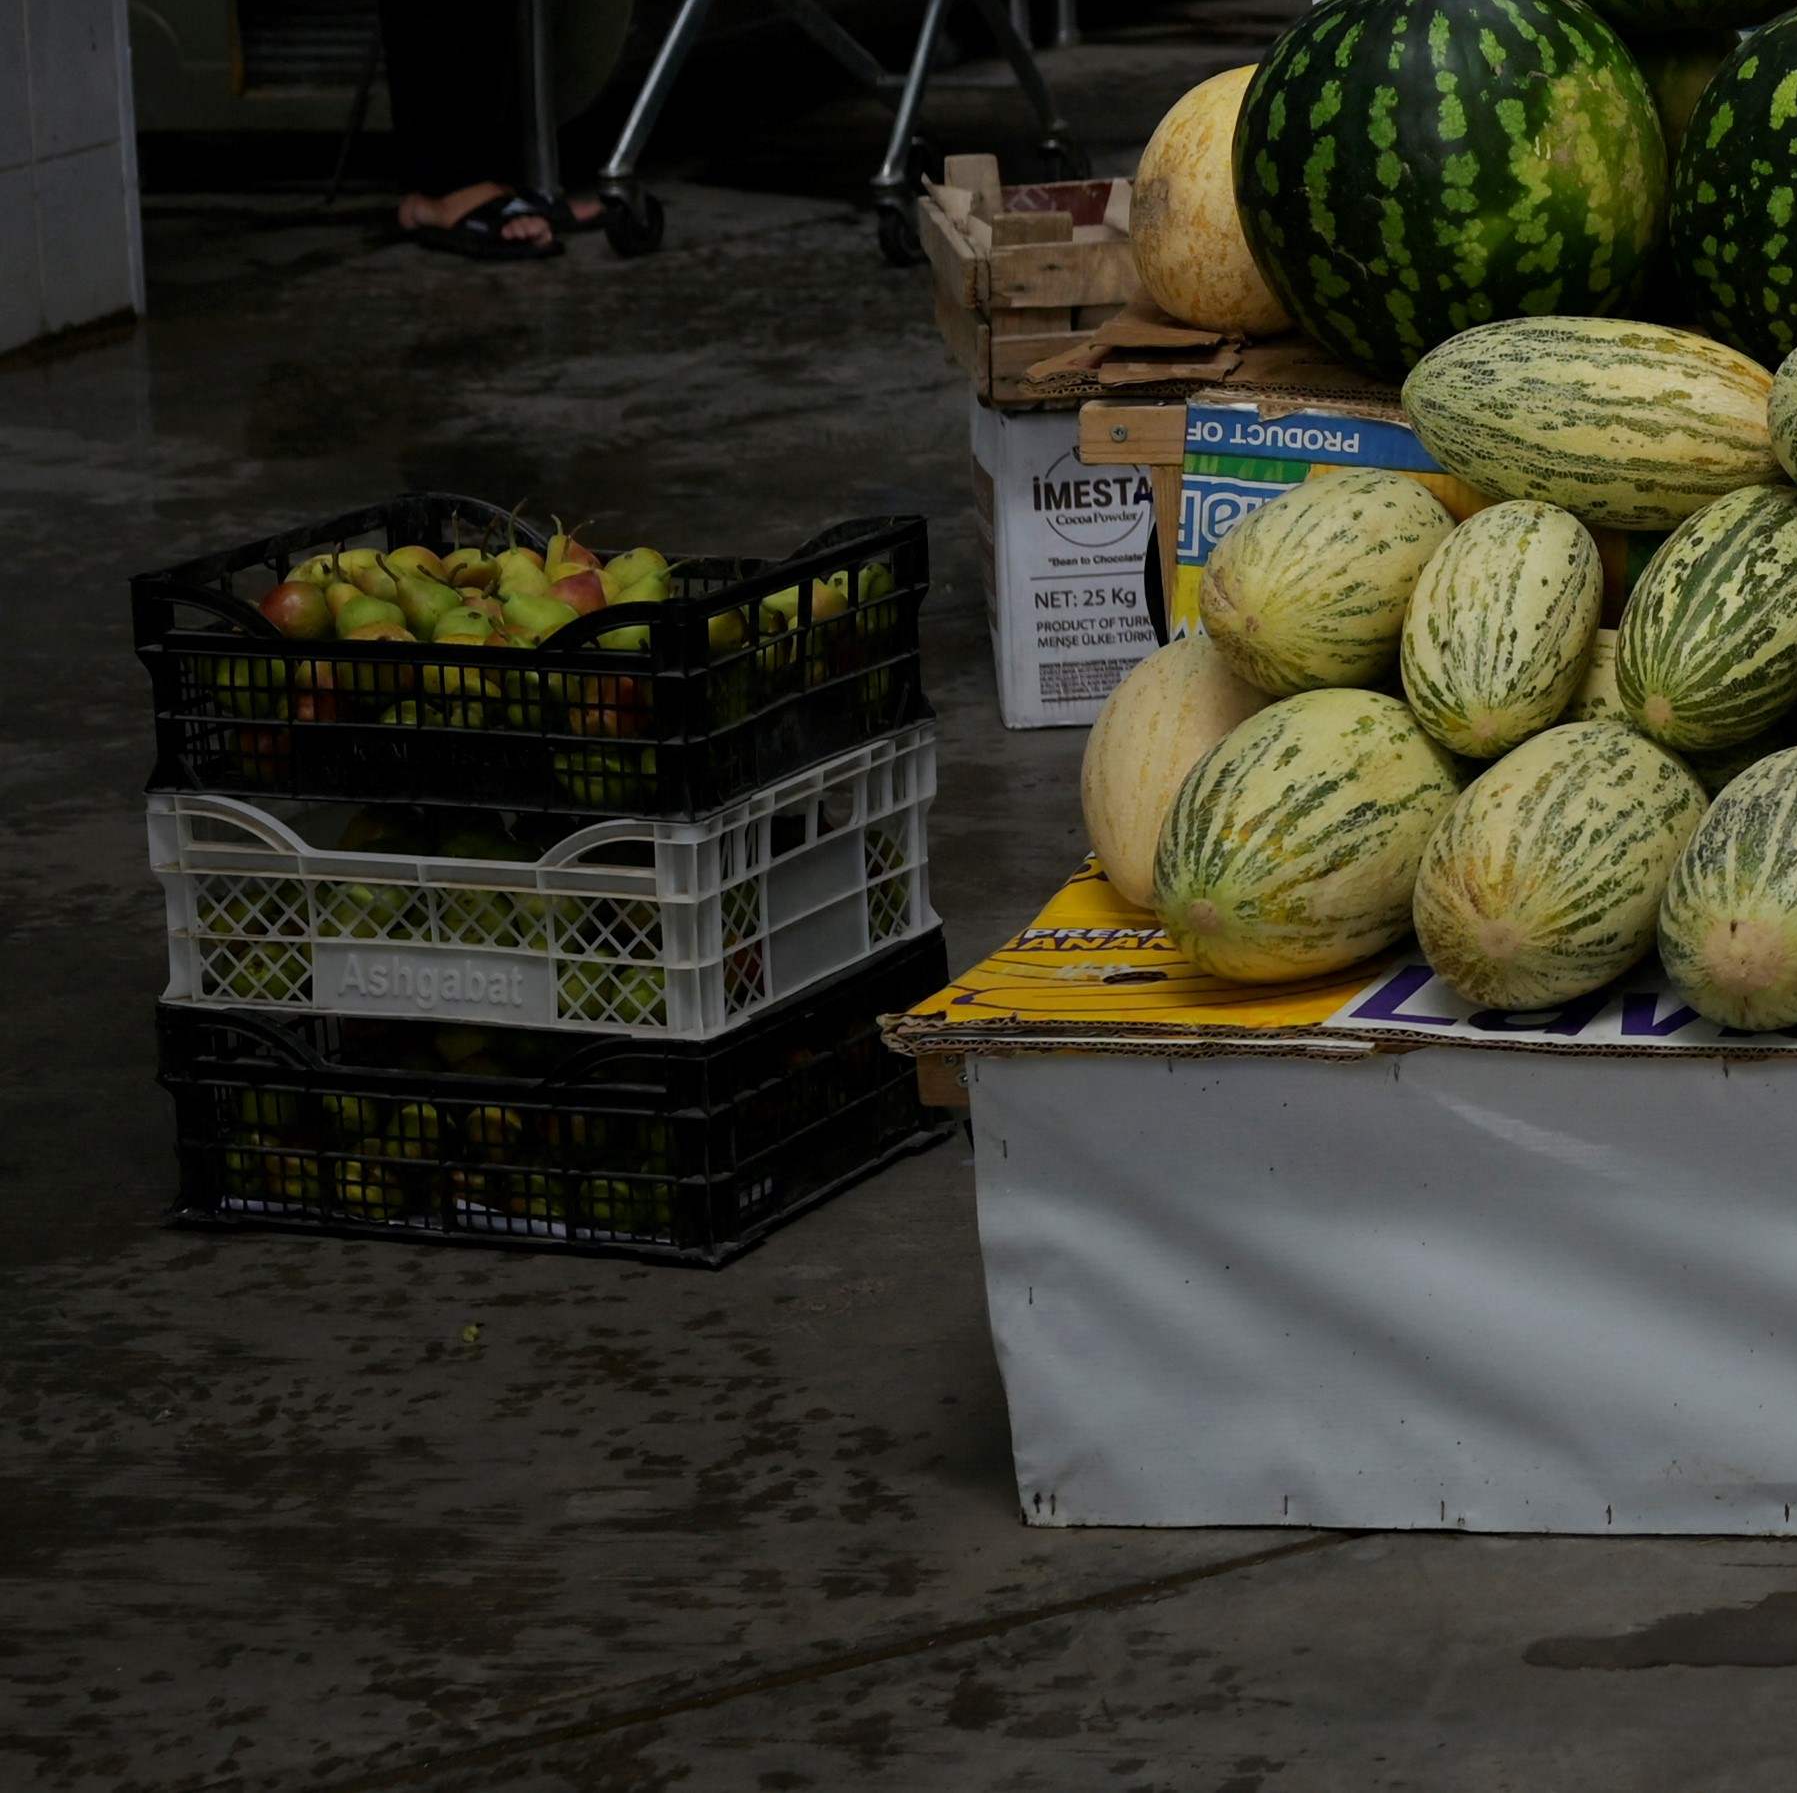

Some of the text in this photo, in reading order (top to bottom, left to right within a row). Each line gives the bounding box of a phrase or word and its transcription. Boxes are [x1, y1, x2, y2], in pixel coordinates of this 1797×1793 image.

[1187, 421, 1360, 454] PRODUCT OF
[1033, 475, 1153, 511] İMESTA
[1055, 510, 1138, 526] Cocoa Powder
[1080, 556, 1091, 566] to
[1034, 587, 1137, 609] NET: 25 Kg
[1036, 618, 1096, 633] PRODUCT
[1099, 617, 1115, 629] OF
[1038, 633, 1078, 649] MENŞE
[338, 952, 524, 1010] Ashgabat
